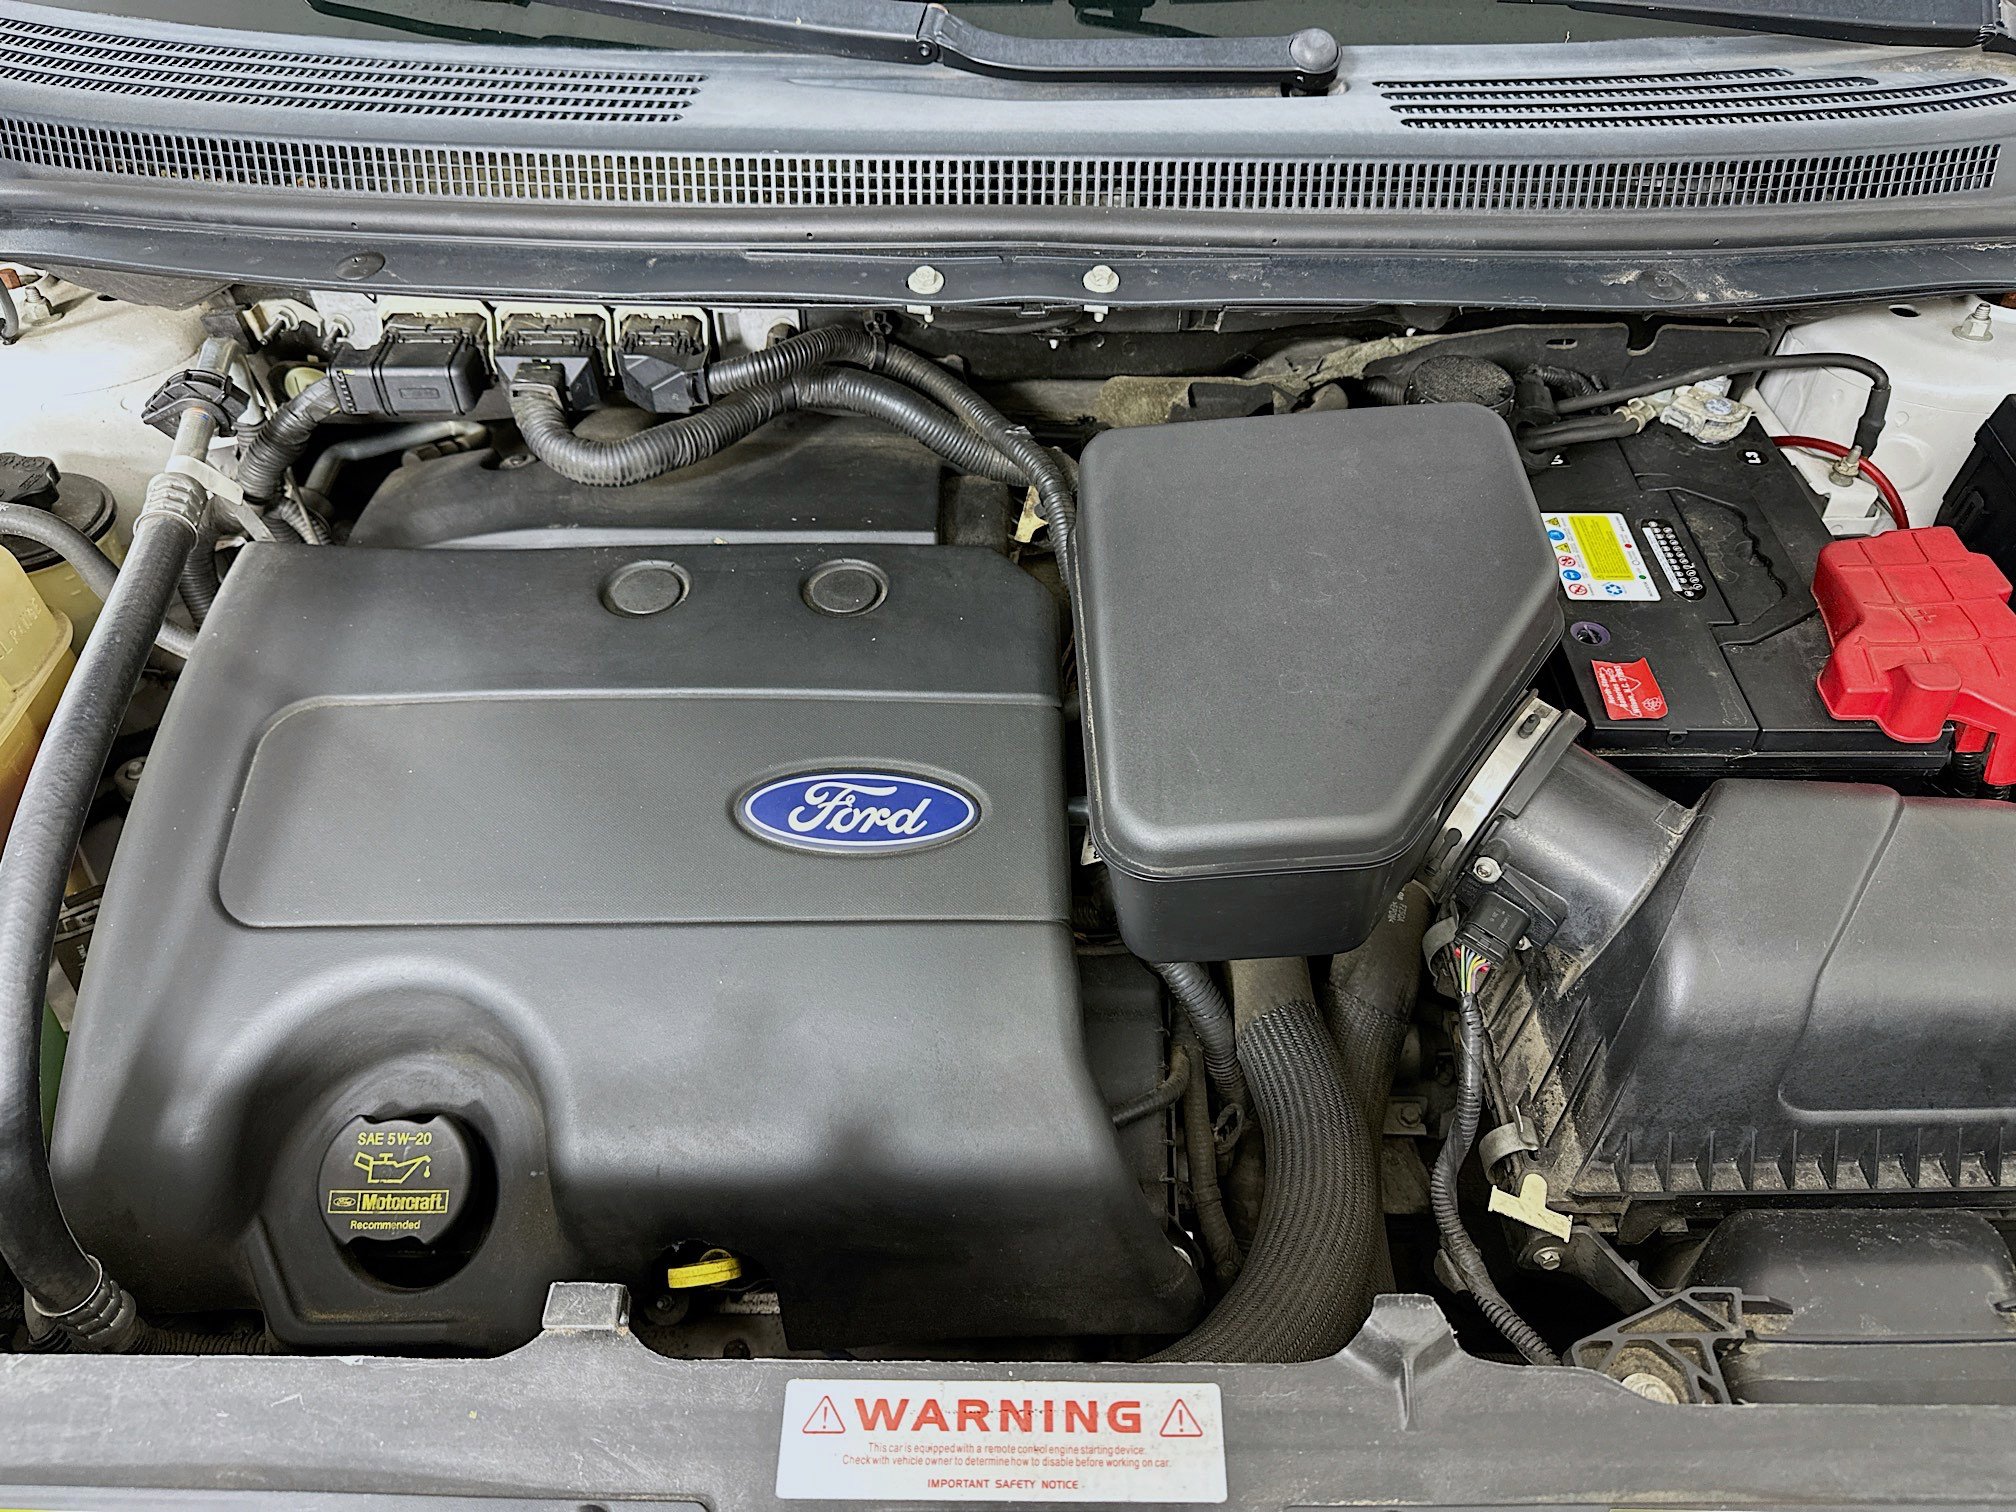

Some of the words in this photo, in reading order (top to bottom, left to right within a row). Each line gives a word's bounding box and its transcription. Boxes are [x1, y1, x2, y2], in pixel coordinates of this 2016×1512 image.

[788, 781, 932, 835] Ford
[357, 1132, 384, 1146] SAE
[387, 1132, 433, 1146] 5W-20
[350, 1219, 421, 1230] Recommended
[854, 1398, 1141, 1434] WARNING
[868, 1442, 887, 1453] This
[889, 1444, 903, 1453] car
[904, 1443, 912, 1453] is
[914, 1444, 956, 1455] equipped
[956, 1444, 975, 1453] with
[977, 1445, 982, 1454] a
[985, 1445, 1015, 1454] remote
[1017, 1444, 1048, 1454] control
[1050, 1445, 1079, 1456] engine
[1080, 1445, 1114, 1457] starting
[842, 1454, 870, 1465] Check
[872, 1455, 890, 1465] with
[892, 1455, 923, 1466] vehicle
[925, 1456, 953, 1466] owner
[955, 1456, 963, 1466] to
[965, 1456, 1010, 1467] determine
[1011, 1456, 1029, 1467] how
[1031, 1457, 1040, 1467] to
[1042, 1457, 1074, 1467] disable
[1075, 1457, 1104, 1467] before
[1106, 1457, 1140, 1469] working
[1142, 1459, 1153, 1468] on
[927, 1479, 990, 1489] IMPORTANT
[995, 1480, 1035, 1489] SAFETY
[1041, 1479, 1079, 1490] NOTICE
